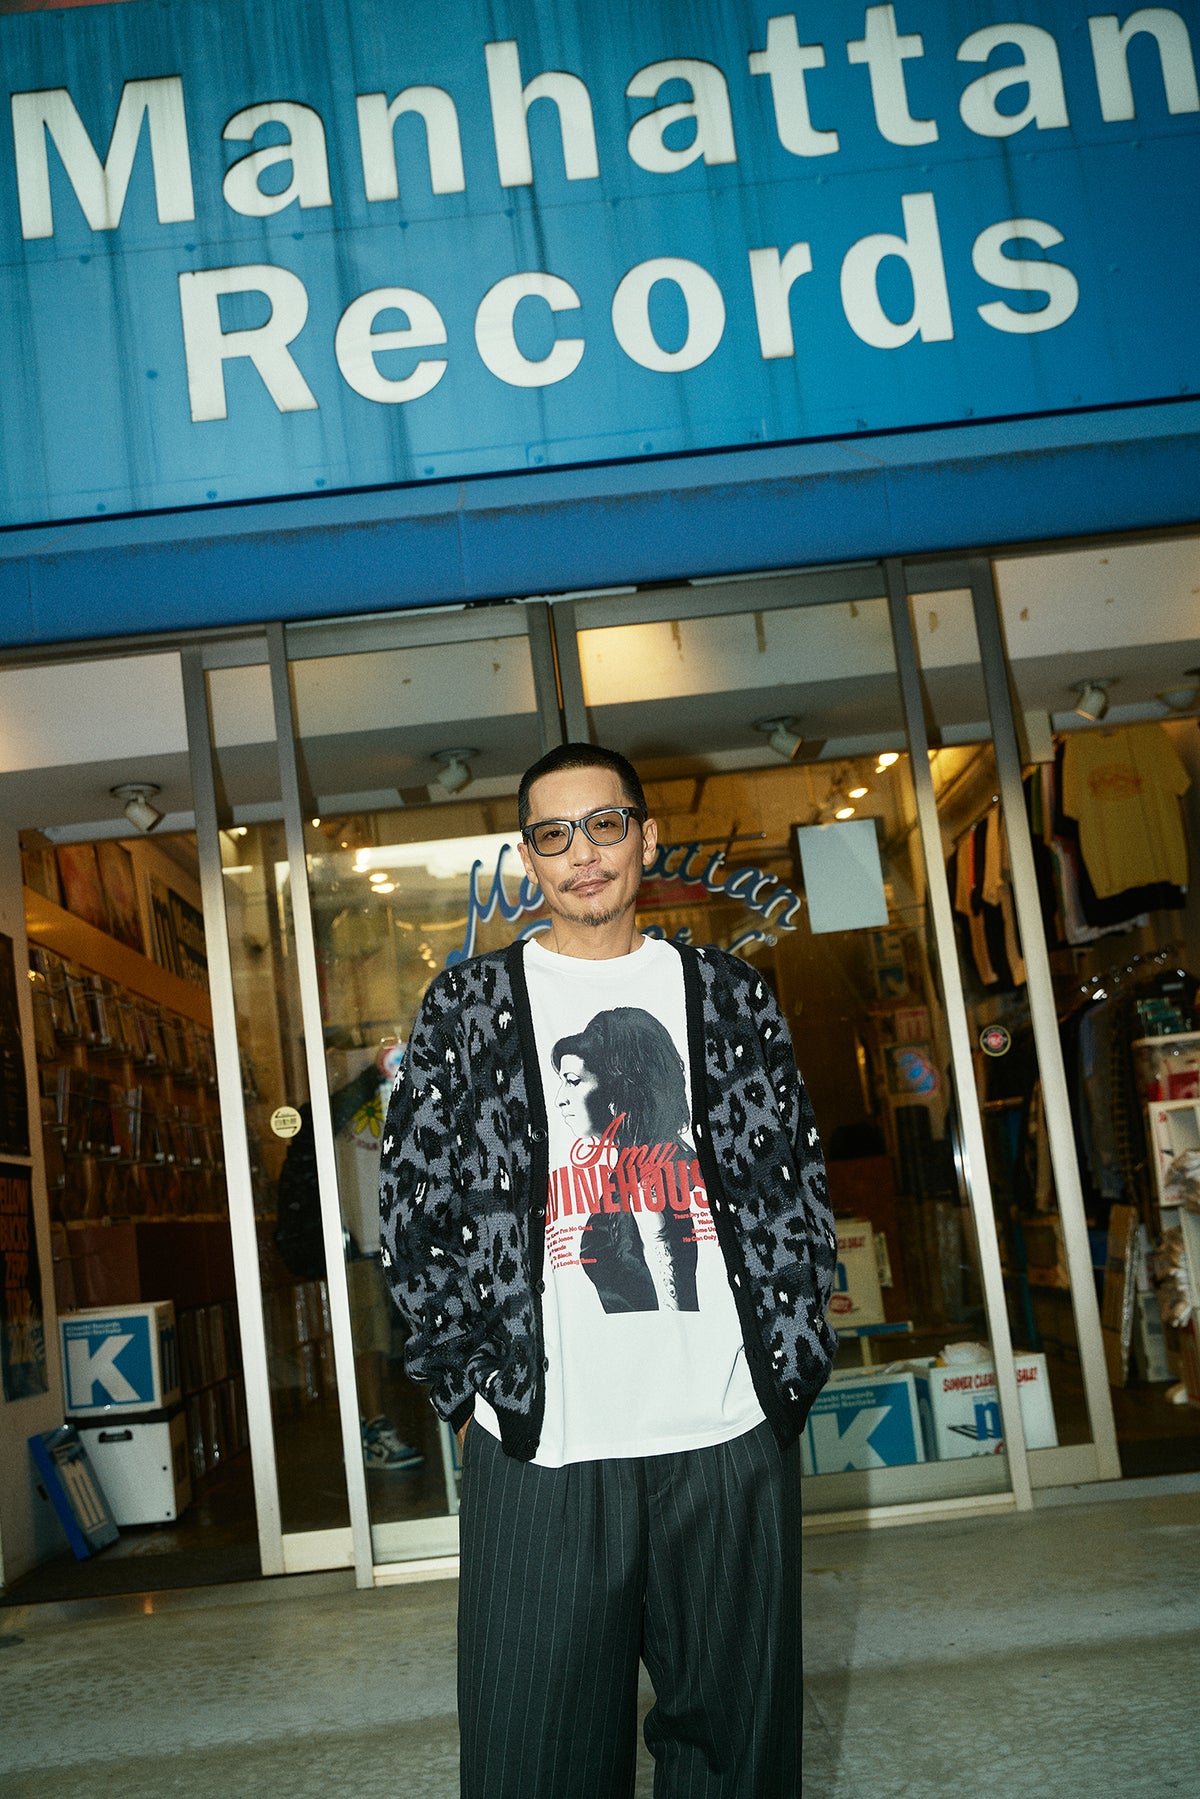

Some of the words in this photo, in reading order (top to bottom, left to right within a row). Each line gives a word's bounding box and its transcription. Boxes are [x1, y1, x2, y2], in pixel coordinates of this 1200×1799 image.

[10, 3, 1200, 240] Manhattan
[178, 192, 1081, 423] Records
[570, 1112, 679, 1190] Amy
[67, 1333, 142, 1407] K
[810, 1405, 893, 1473] K
